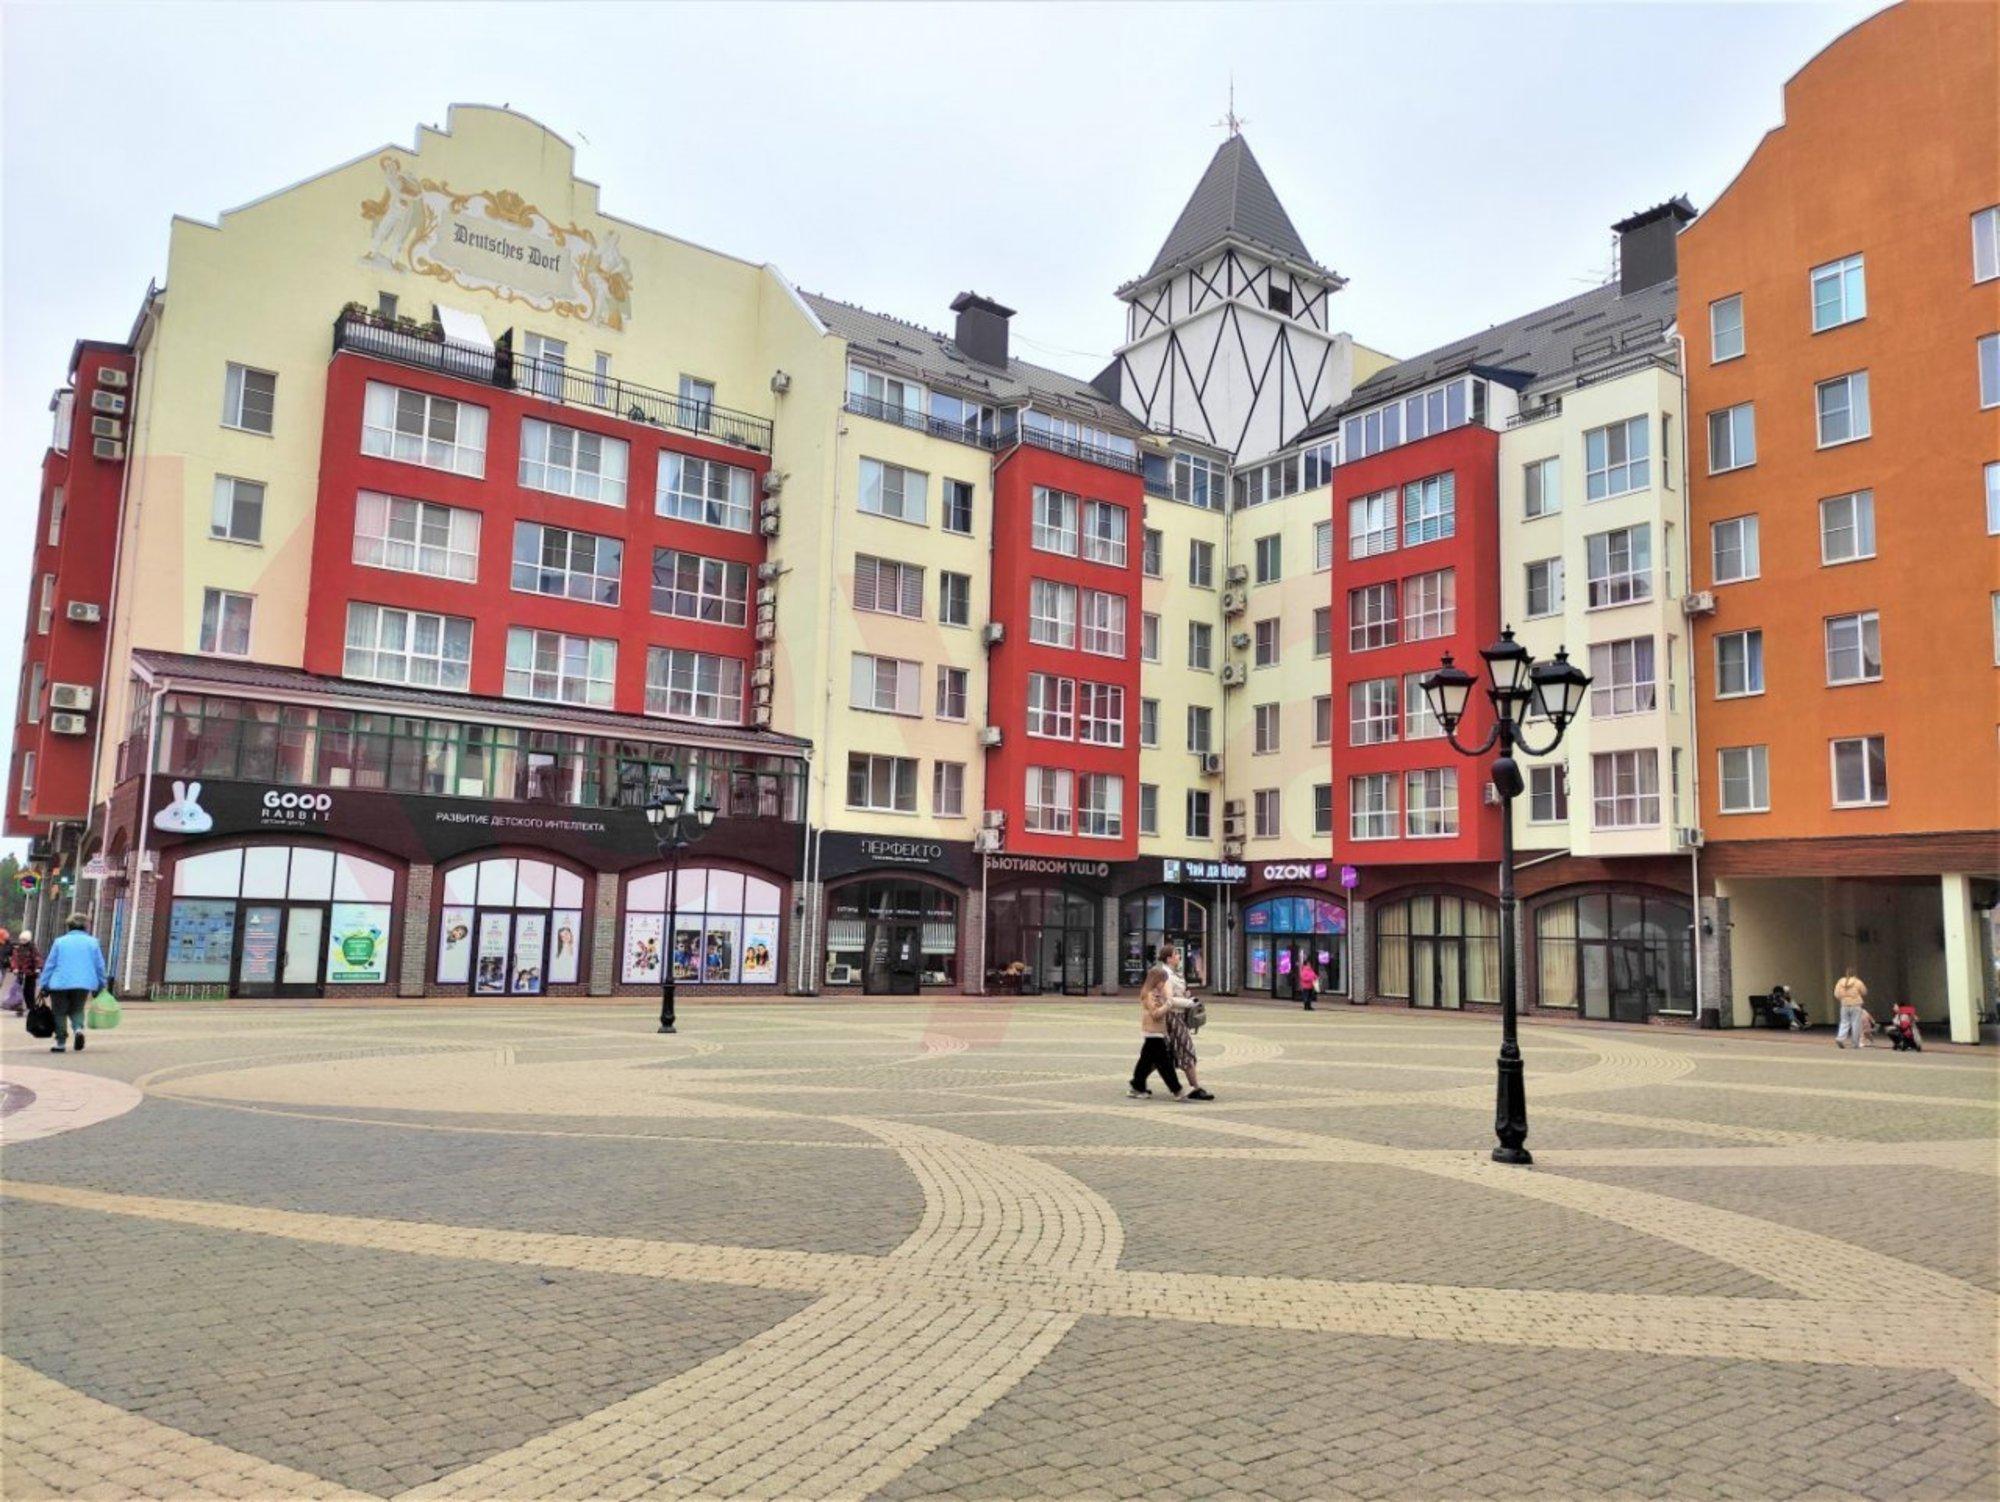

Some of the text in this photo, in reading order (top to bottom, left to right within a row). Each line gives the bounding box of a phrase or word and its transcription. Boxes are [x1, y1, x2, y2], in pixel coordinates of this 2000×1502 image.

[454, 222, 561, 272] Deutsches Dorf
[263, 790, 332, 811] GOOD
[435, 812, 606, 832] РАЗВИТИЕ ДЕТСКОГО ИНТЕЛЛЕКТА
[861, 840, 942, 858] ПЕРФЕКТО
[1263, 865, 1312, 880] OZON
